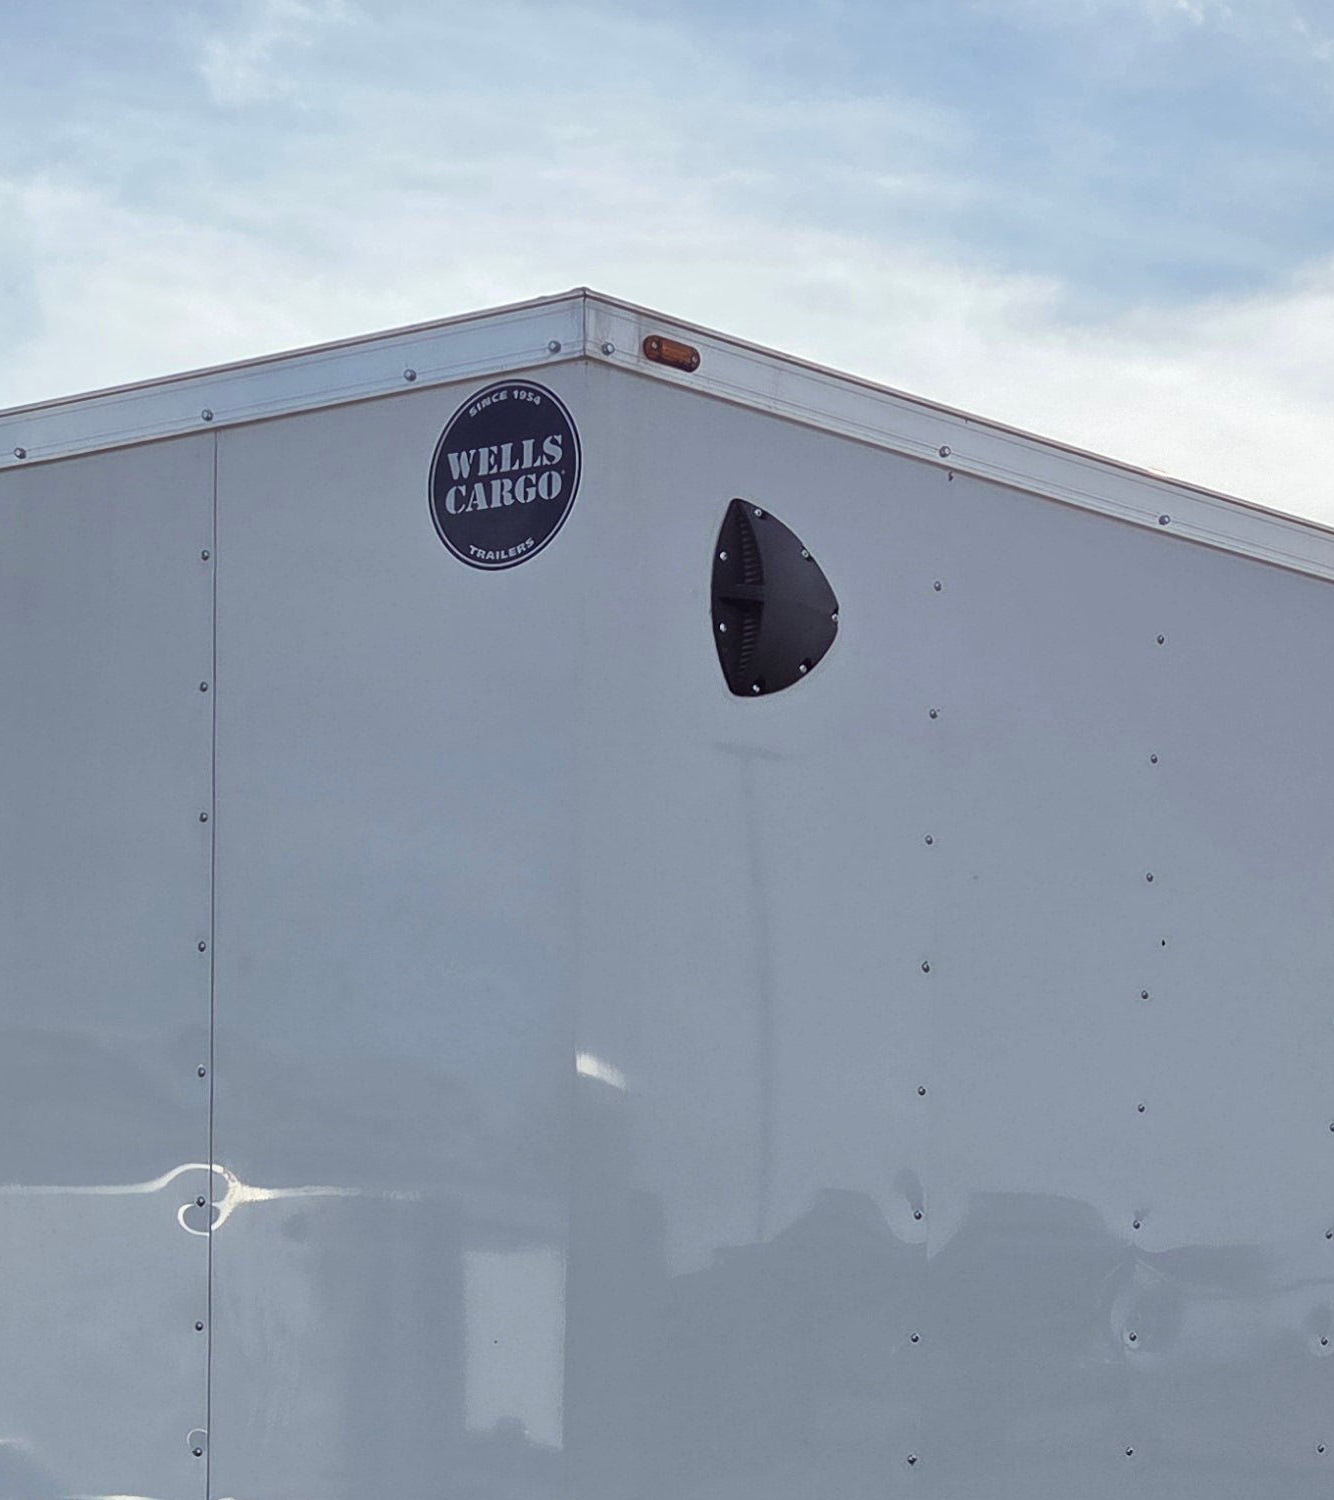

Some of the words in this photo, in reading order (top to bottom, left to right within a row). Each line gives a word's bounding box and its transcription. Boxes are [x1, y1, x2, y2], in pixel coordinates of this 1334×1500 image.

[469, 390, 508, 417] SINCE
[513, 390, 542, 406] 1954
[447, 434, 563, 480] WELLS
[445, 470, 563, 514] CARGO
[469, 537, 535, 560] TRAILERS
